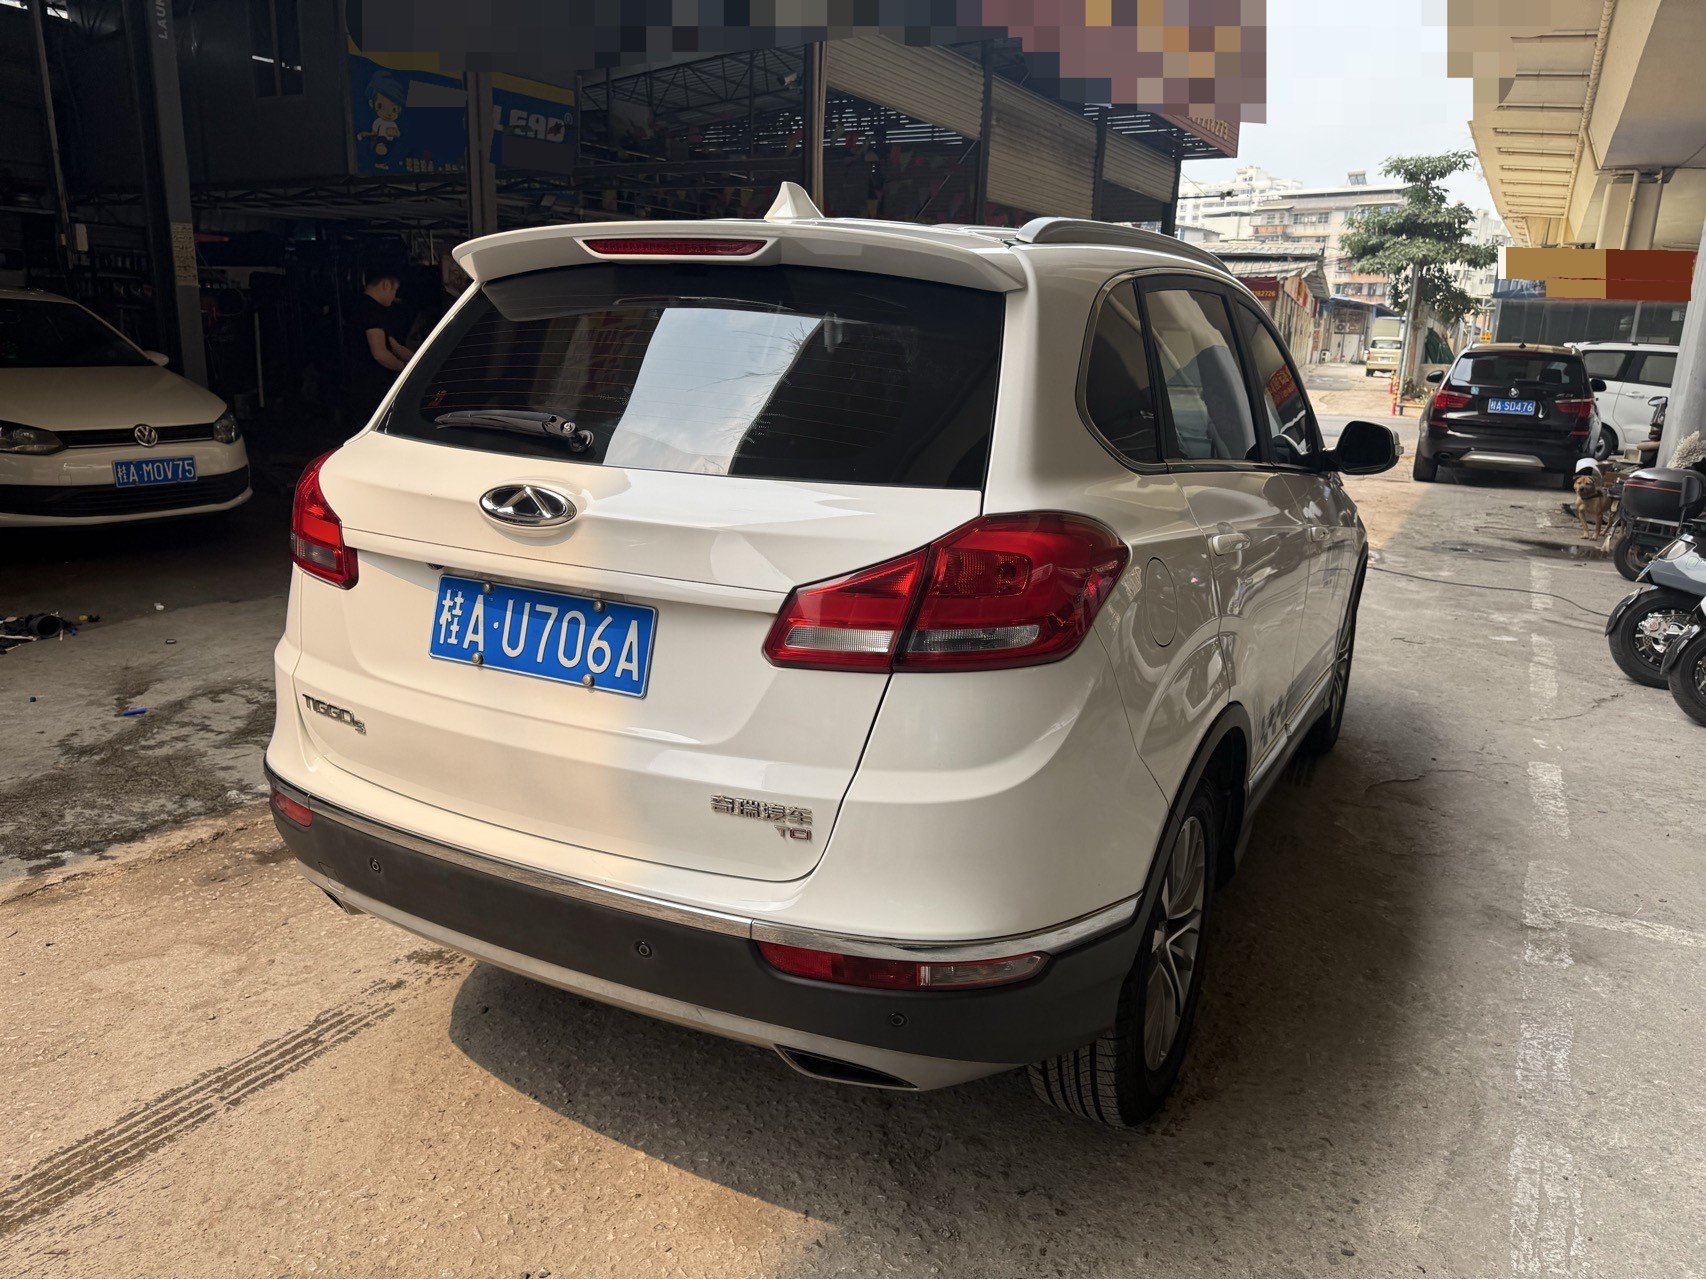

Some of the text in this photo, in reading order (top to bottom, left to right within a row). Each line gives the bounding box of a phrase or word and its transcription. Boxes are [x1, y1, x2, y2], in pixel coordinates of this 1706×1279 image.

[439, 589, 639, 681] 桂A·U706A
[710, 795, 813, 825] 奇瑞汽车
